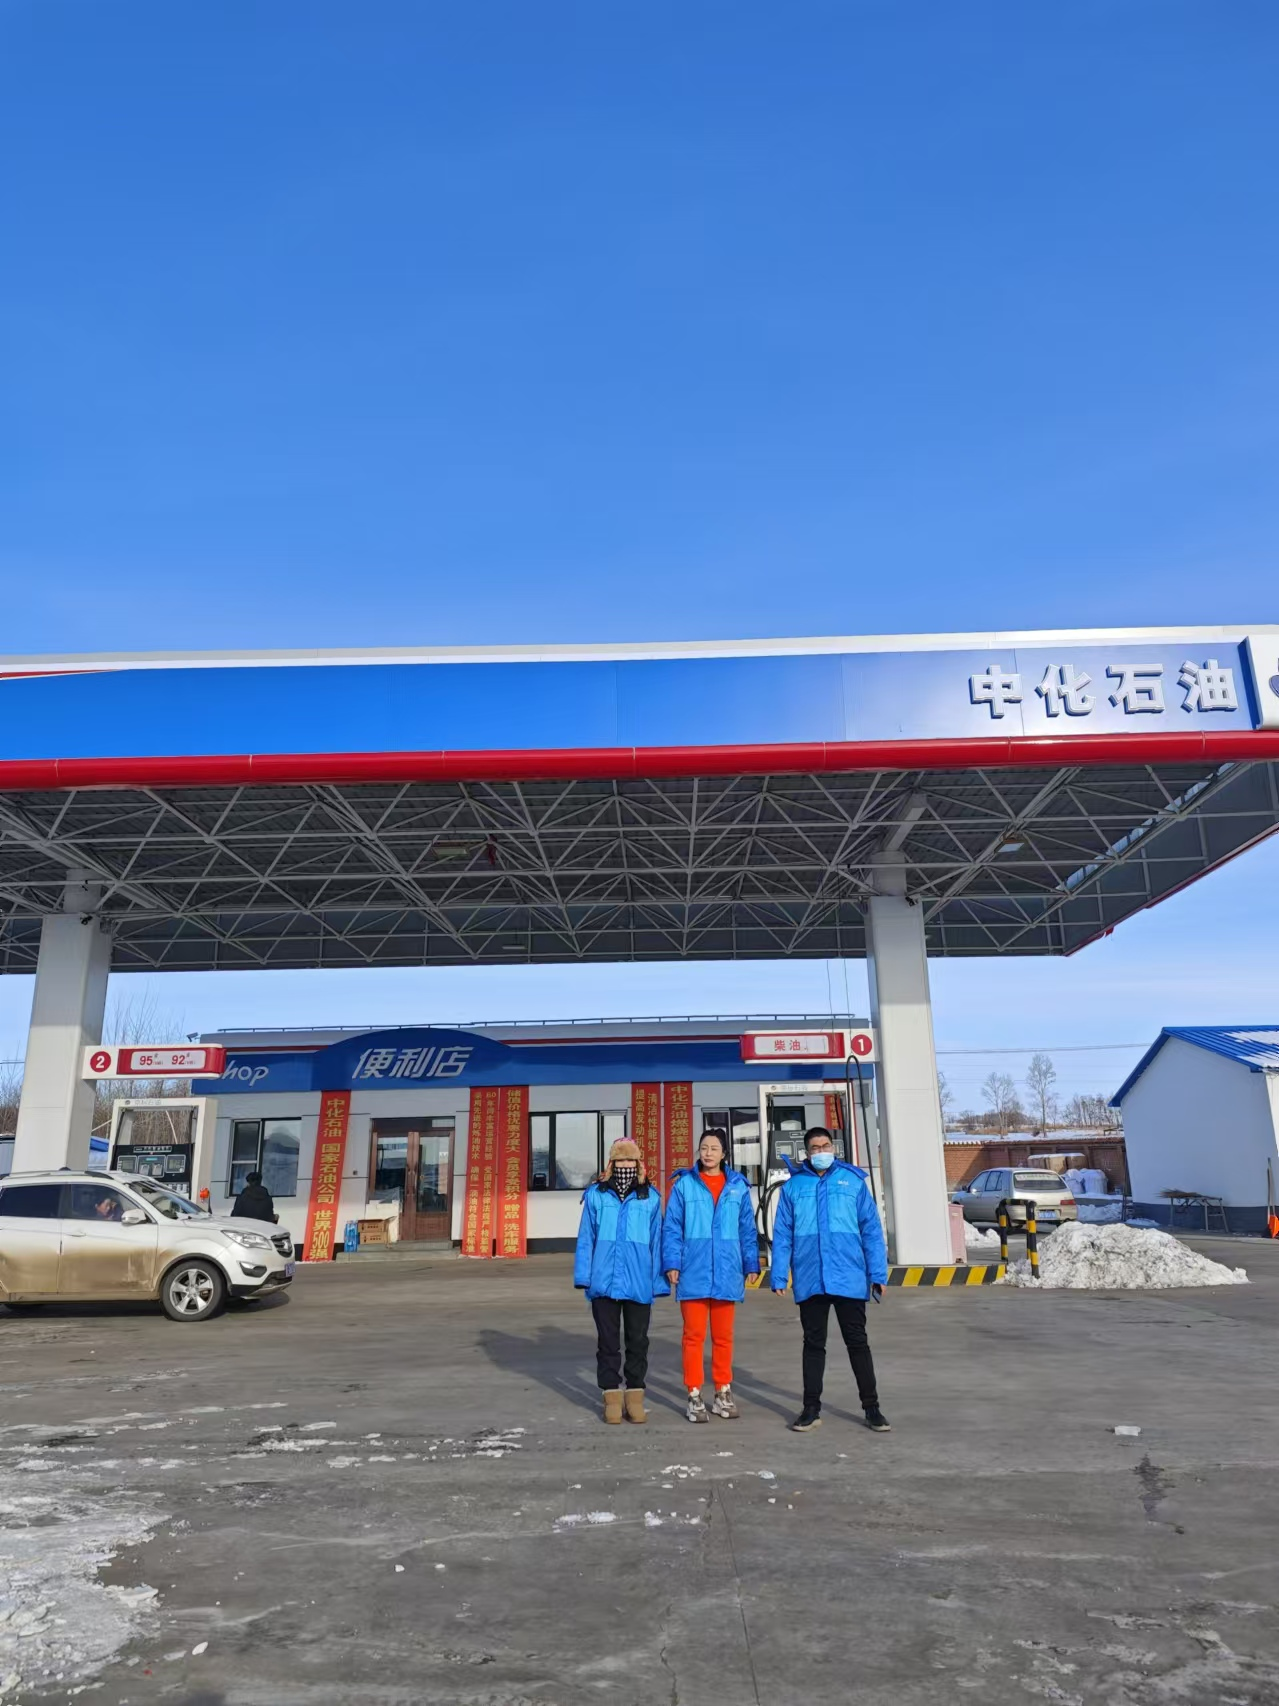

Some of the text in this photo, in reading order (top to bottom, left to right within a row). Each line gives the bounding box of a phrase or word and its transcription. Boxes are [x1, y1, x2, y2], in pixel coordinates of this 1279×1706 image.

[970, 658, 1239, 719] 中化石油
[774, 1039, 800, 1051] 柴油
[858, 1038, 865, 1052] 1
[95, 1055, 105, 1069] 2
[211, 1060, 269, 1086] hop
[352, 1046, 474, 1079] 便利店
[648, 1093, 658, 1152] 清洁性能好
[671, 1085, 689, 1153] 中化石油燃烧率高
[310, 1098, 346, 1259] 中化石油 国家石油公司 世界500强
[505, 1157, 521, 1200] 会员享受积分
[504, 1204, 520, 1219] 赠品
[504, 1223, 520, 1253] 洗车服务
